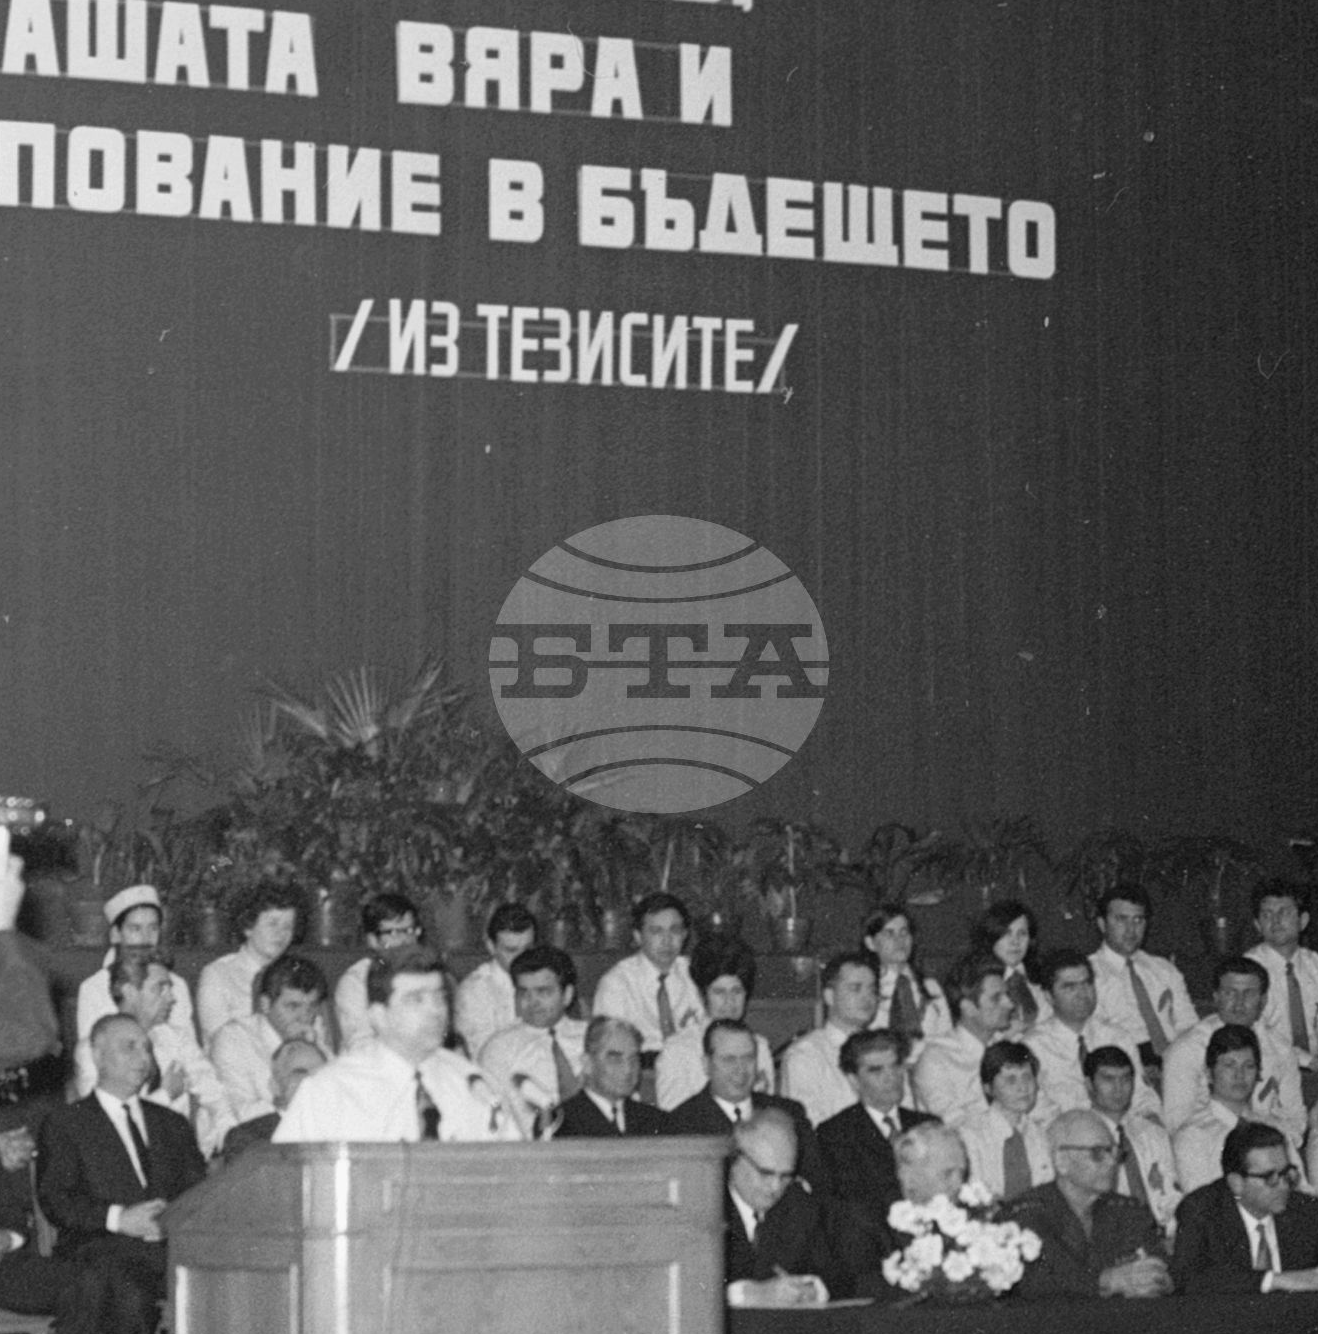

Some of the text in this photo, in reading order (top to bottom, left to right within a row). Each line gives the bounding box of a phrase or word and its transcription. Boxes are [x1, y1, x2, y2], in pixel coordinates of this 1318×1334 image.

[396, 21, 643, 119] ВЯРА
[680, 43, 732, 126] И
[489, 159, 544, 242] В
[579, 165, 1055, 278] БЪДЕЩЕТО
